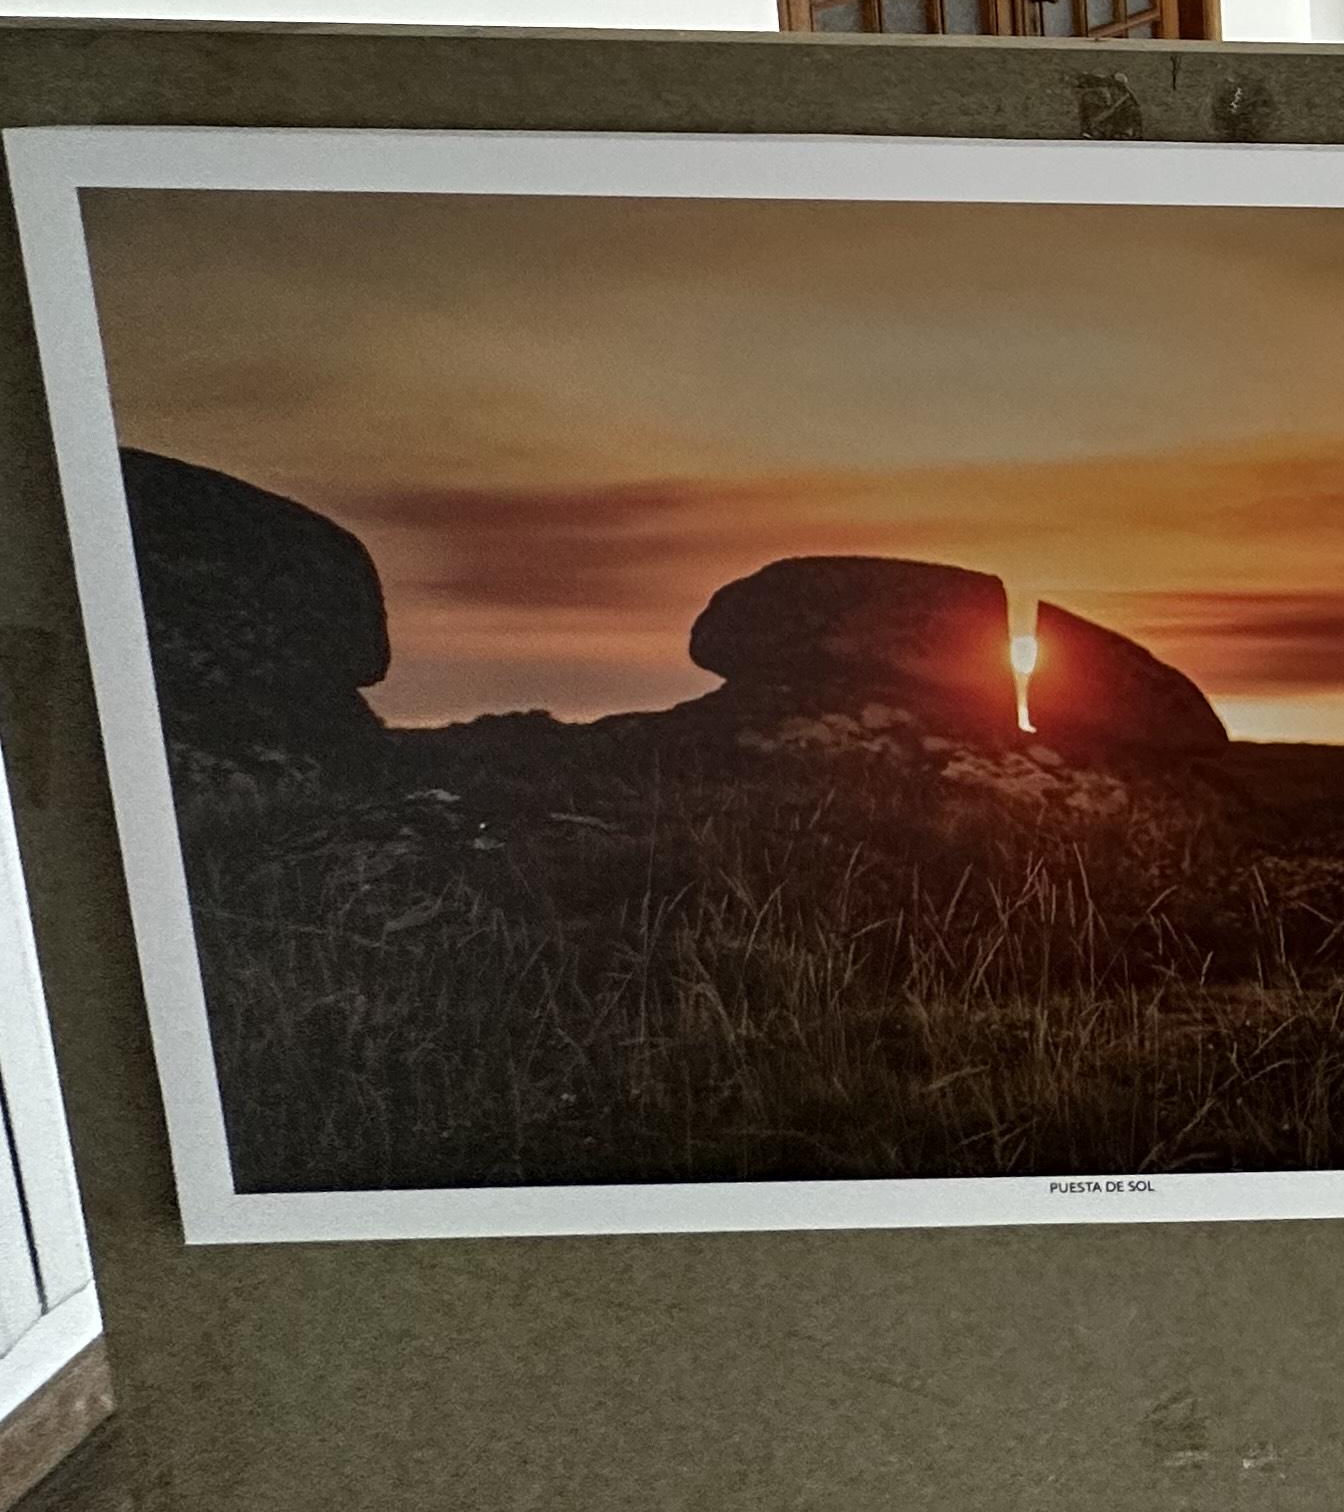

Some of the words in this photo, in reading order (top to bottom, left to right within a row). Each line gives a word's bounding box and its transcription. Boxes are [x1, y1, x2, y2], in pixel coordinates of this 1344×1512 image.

[1049, 1181, 1102, 1194] PUESTA
[1105, 1181, 1124, 1193] DE
[1128, 1180, 1155, 1192] SOL
